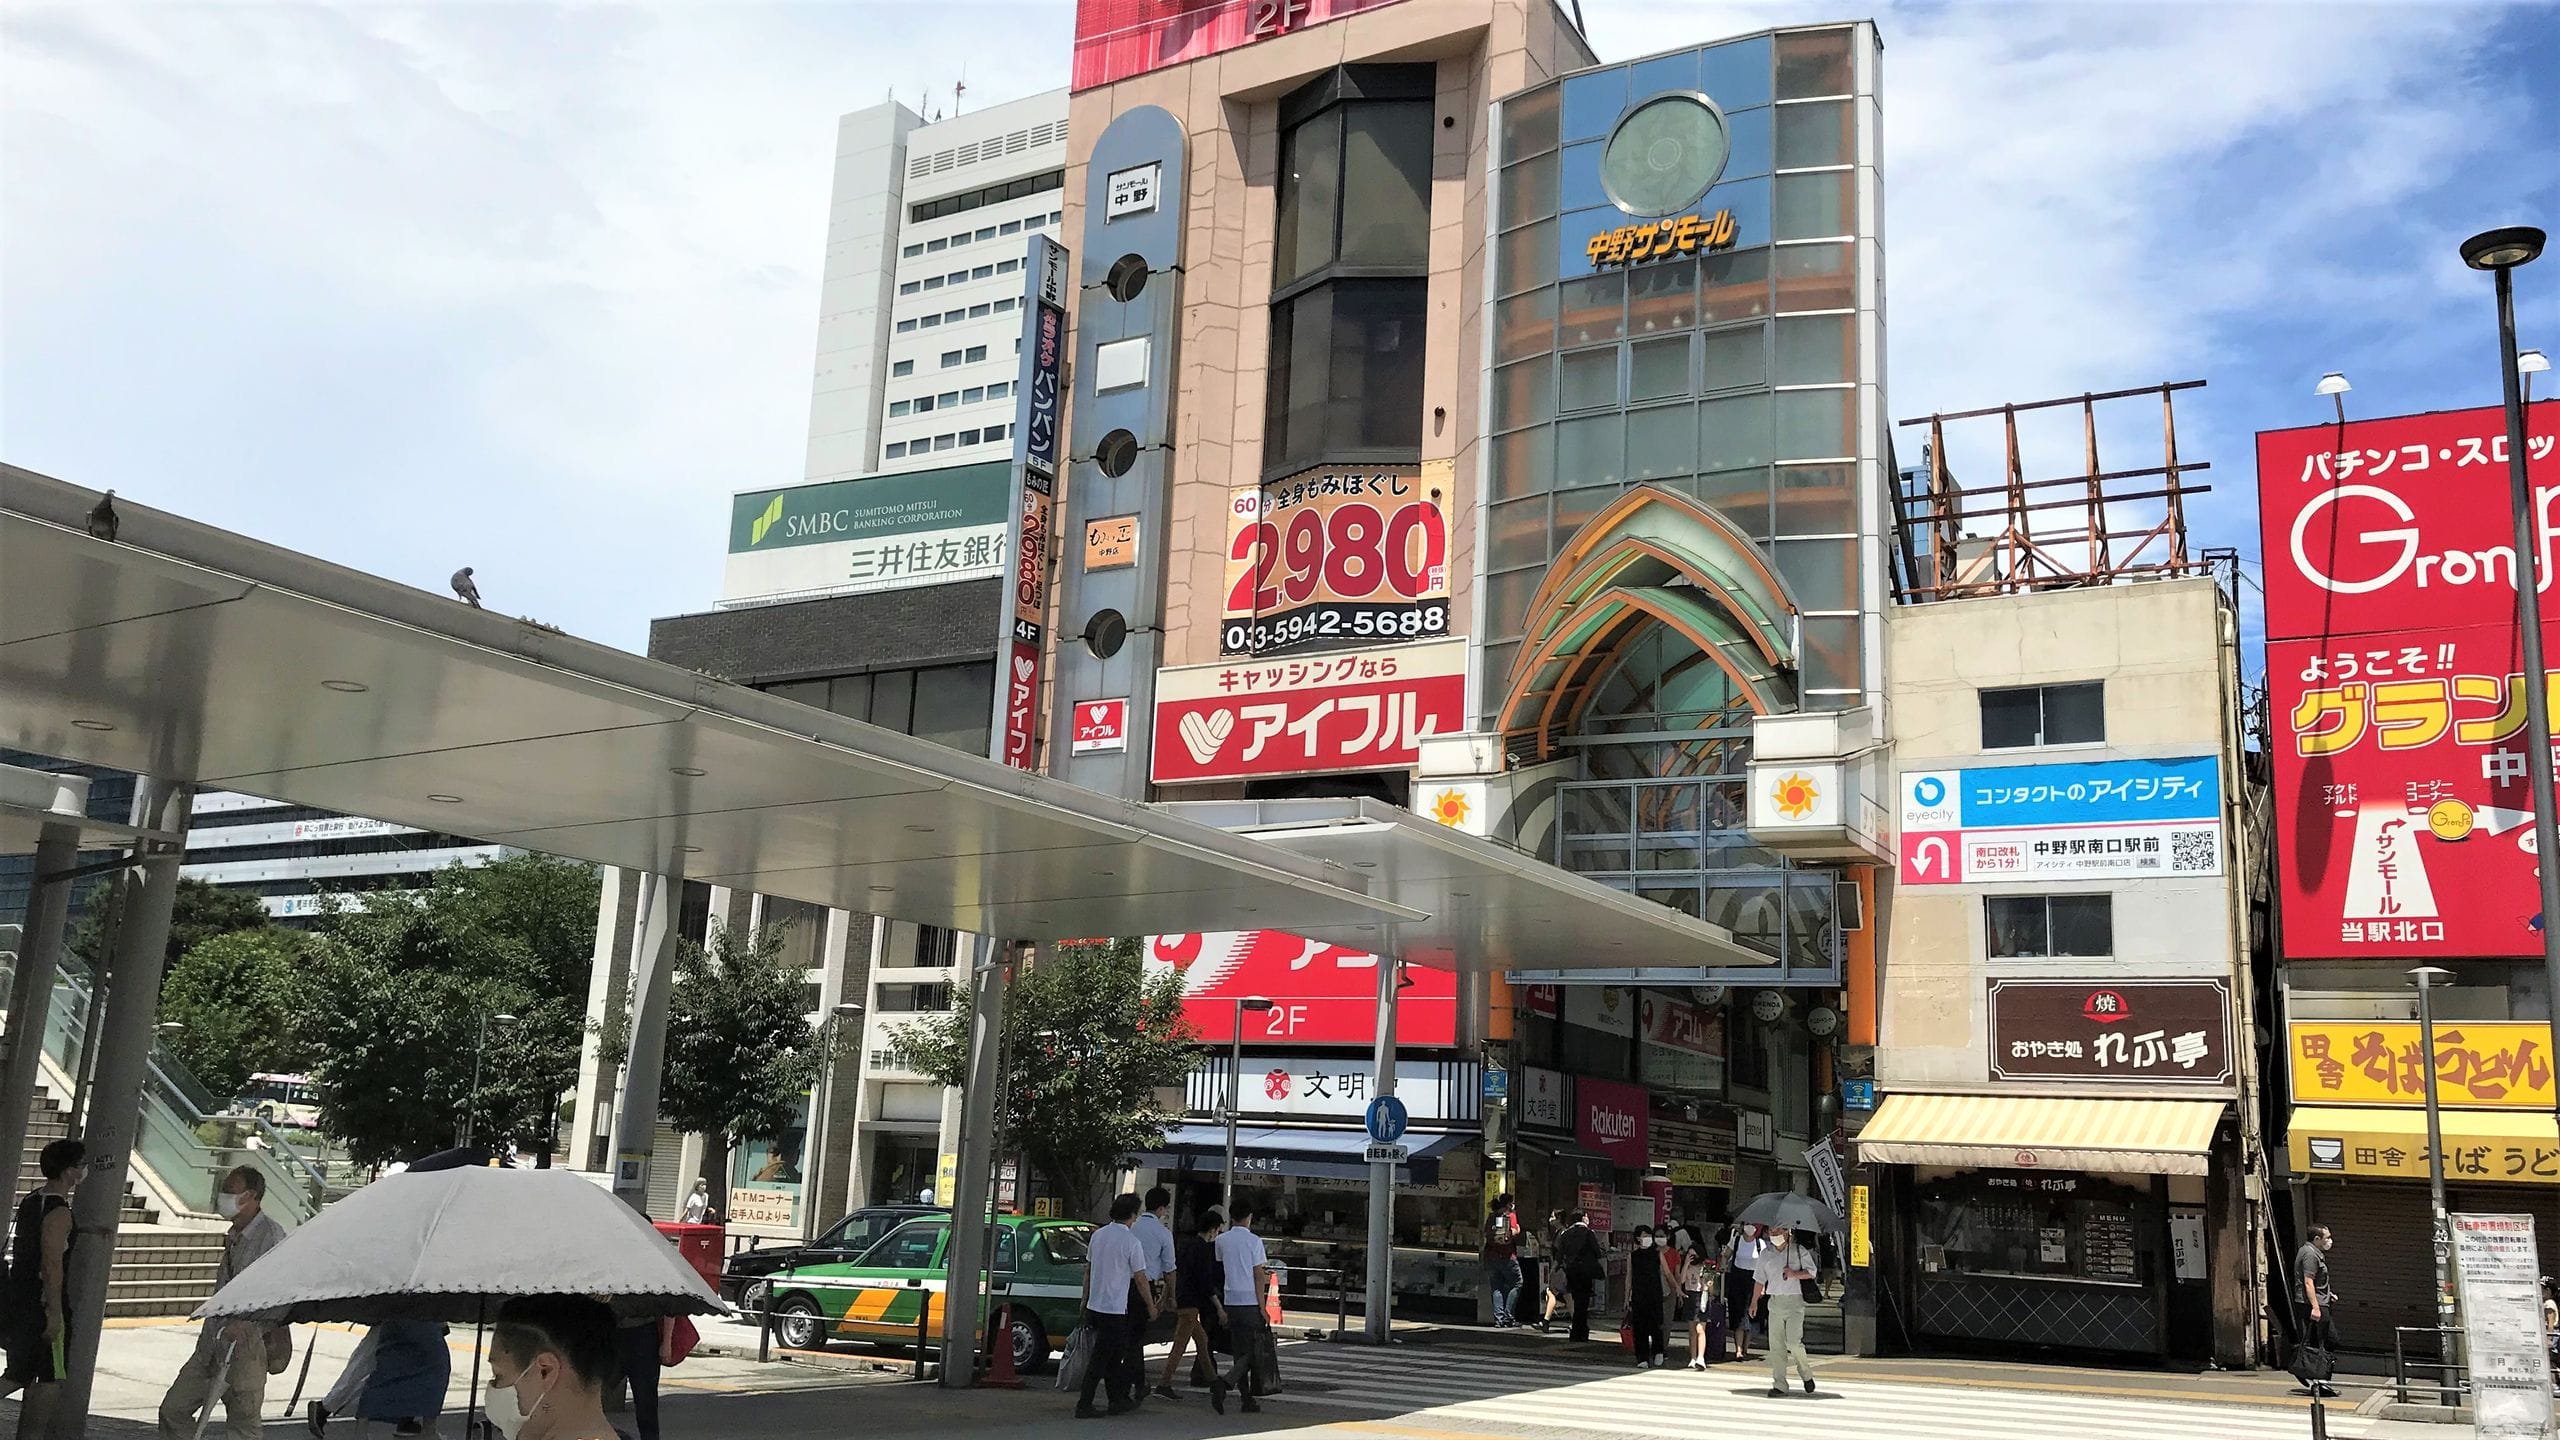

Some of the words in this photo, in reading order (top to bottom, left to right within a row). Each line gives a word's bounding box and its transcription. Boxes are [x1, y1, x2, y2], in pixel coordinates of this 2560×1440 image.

[1115, 177, 1149, 191] サンモール
[1114, 187, 1149, 207] 中野
[1586, 208, 1737, 267] 中野サンモール
[1045, 244, 1059, 302] サンモール中野
[1031, 369, 1056, 452] バンバン
[1277, 473, 1408, 510] 全身もみほぐし
[786, 509, 849, 537] SMBC
[855, 504, 904, 518] SUMITOMO
[906, 500, 937, 512] MITSUI
[854, 517, 894, 530] BANKING
[897, 508, 963, 525] CORPORATION
[1431, 576, 1443, 591] 円
[1016, 620, 1037, 640] 4F
[1226, 607, 1444, 649] 03-5942-5688
[1218, 656, 1397, 692] キャッシングなら
[1080, 723, 1114, 739] アイフル
[1240, 691, 1437, 762] アイフル
[1976, 775, 2203, 806] コンタクトのアイシティ
[2323, 783, 2357, 794] マクド
[2406, 781, 2453, 792] コージー
[2324, 794, 2358, 804] ナルド
[2407, 792, 2454, 802] コーナー
[1906, 808, 1954, 823] eyecity
[1976, 846, 2020, 858] 南口改札
[2034, 837, 2160, 856] 中野駅南口駅前
[1976, 857, 2020, 869] から1分!
[2036, 861, 2073, 869] アイシティ
[2076, 858, 2132, 868] 中野駅前南口店
[2376, 834, 2402, 915] サンモール
[2341, 920, 2444, 943] 当駅北口
[2095, 993, 2117, 1013] 焼
[1266, 1006, 1307, 1035] 2F
[2011, 1040, 2083, 1059] おやき処
[2093, 1030, 2208, 1069] れふ亭
[2301, 1033, 2345, 1090] 田舎
[1303, 1070, 1399, 1101] 文明
[1591, 1104, 1636, 1138] Rakuten
[1366, 1147, 1405, 1159] 自転車を除く
[2355, 1146, 2407, 1167] 田舎
[1243, 1156, 1281, 1171] 文明堂
[2040, 1178, 2078, 1192] れふ亭
[2099, 1214, 2126, 1222] MENU
